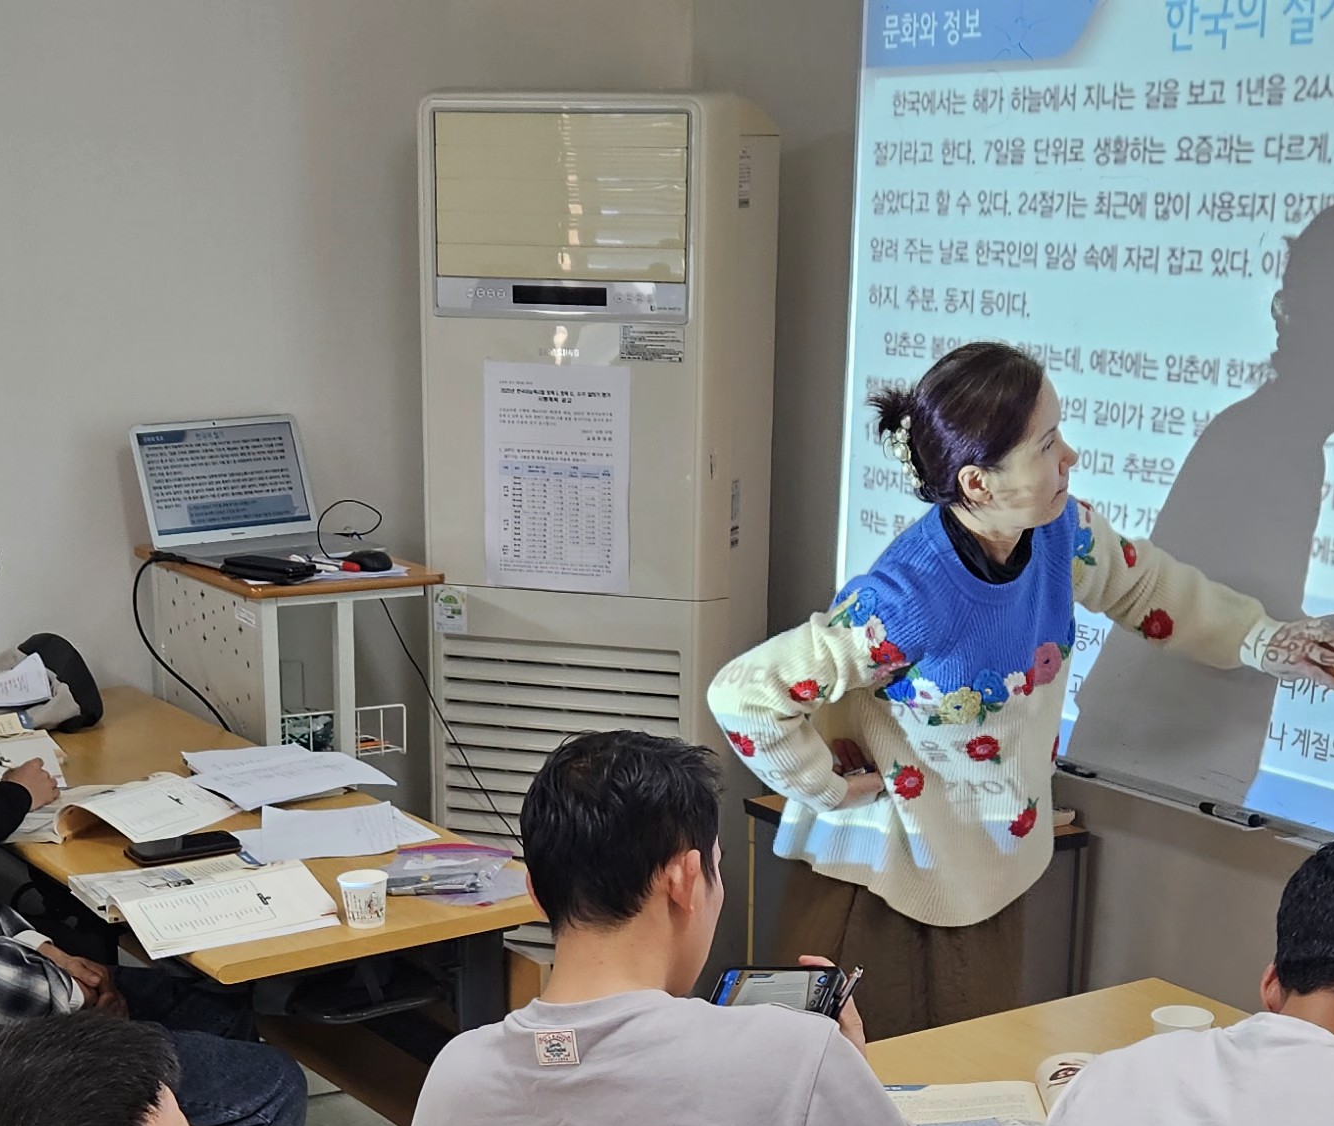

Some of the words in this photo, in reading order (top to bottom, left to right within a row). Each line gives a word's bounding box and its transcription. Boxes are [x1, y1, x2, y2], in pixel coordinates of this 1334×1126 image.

[882, 13, 939, 49] 문화와
[943, 9, 982, 46] 정보
[1165, 0, 1266, 52] 한국의
[892, 88, 968, 118] 한국에서는
[972, 86, 1005, 115] 해가
[1010, 83, 1077, 114] 하늘에서
[1082, 81, 1137, 112] 지나는
[1144, 77, 1181, 111] 길을
[1186, 79, 1227, 106] 보고
[1235, 73, 1287, 107] 1년을
[873, 139, 934, 168] 절기라고
[984, 136, 1027, 167] 7일을
[1033, 136, 1086, 166] 단위로
[1092, 135, 1167, 167] 생활하는
[1174, 134, 1256, 166] 요즘과는
[1263, 132, 1333, 165] 다르게,
[871, 189, 931, 216] 살았다고
[935, 188, 951, 217] 할
[955, 189, 972, 217] 수
[976, 189, 1012, 217] 있다.
[1017, 190, 1089, 220] 24절기는
[1093, 190, 1148, 220] 최근에
[1153, 191, 1191, 222] 많이
[1196, 191, 1277, 223] 사용되지
[870, 236, 899, 263] 알려
[903, 237, 935, 265] 주는
[938, 239, 970, 266] 날로
[975, 239, 1039, 269] 한국인의
[1044, 241, 1078, 272] 일상
[1083, 243, 1119, 273] 속에
[1122, 244, 1160, 275] 자리
[1166, 246, 1204, 276] 잡고
[1210, 247, 1253, 279] 있다.
[943, 287, 976, 315] 동지
[979, 289, 1031, 319] 등이다.
[884, 331, 926, 359] 입춘은
[1090, 348, 1159, 381] 예전에는
[1166, 354, 1220, 385] 입춘에
[1093, 399, 1145, 431] 길이가
[1150, 406, 1185, 436] 같은
[1123, 453, 1175, 485] 추분은
[860, 508, 888, 535] 막는
